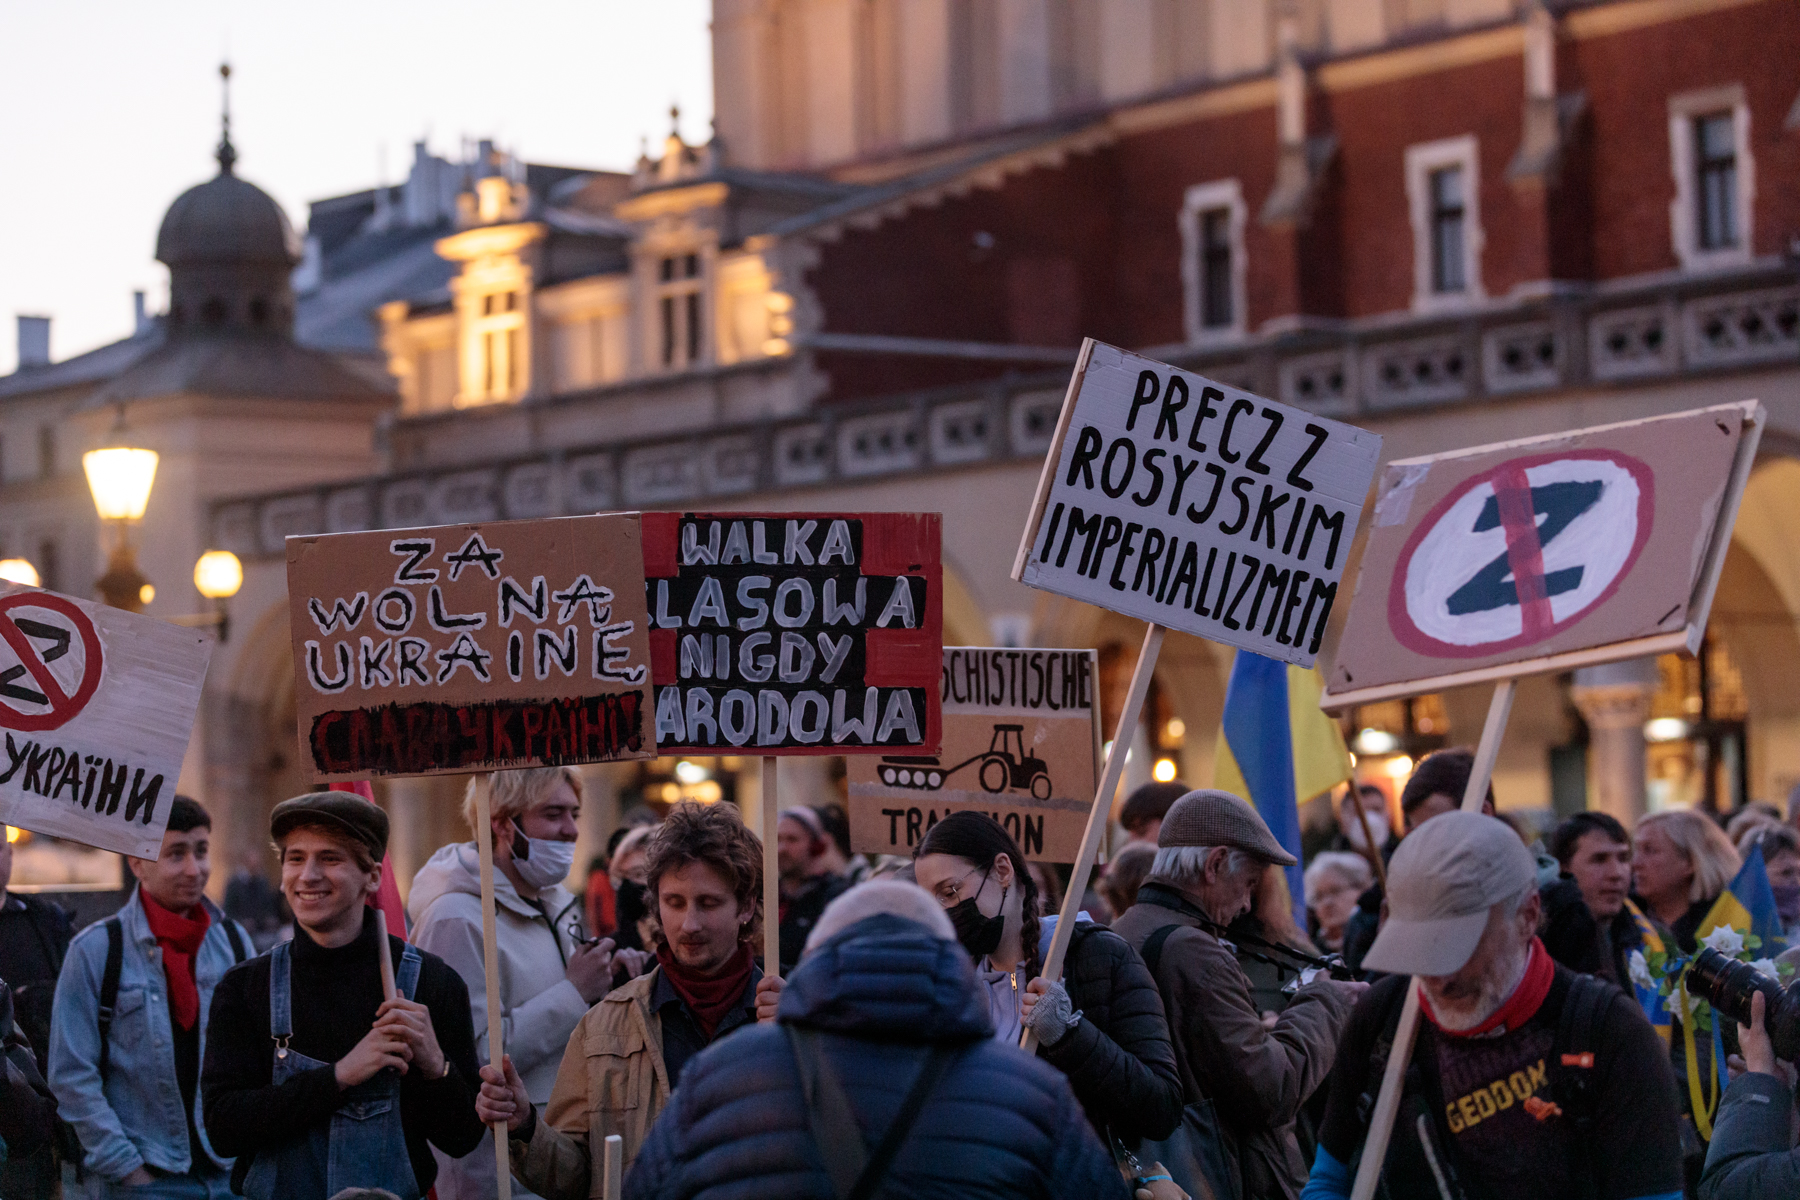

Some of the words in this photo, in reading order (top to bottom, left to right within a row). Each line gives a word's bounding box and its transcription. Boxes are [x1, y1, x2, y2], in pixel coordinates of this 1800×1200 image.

[1125, 369, 1284, 475] PRECZ
[1286, 423, 1329, 492] Z
[1066, 426, 1345, 570] ROSYJSKIM
[389, 532, 504, 584] ZA
[681, 520, 855, 566] WALKA
[1039, 502, 1338, 654] IMPERIALIZMEM
[645, 575, 916, 631] LASOWA
[680, 631, 853, 683] NIGDY
[0, 731, 164, 825] УКРАЇНИ
